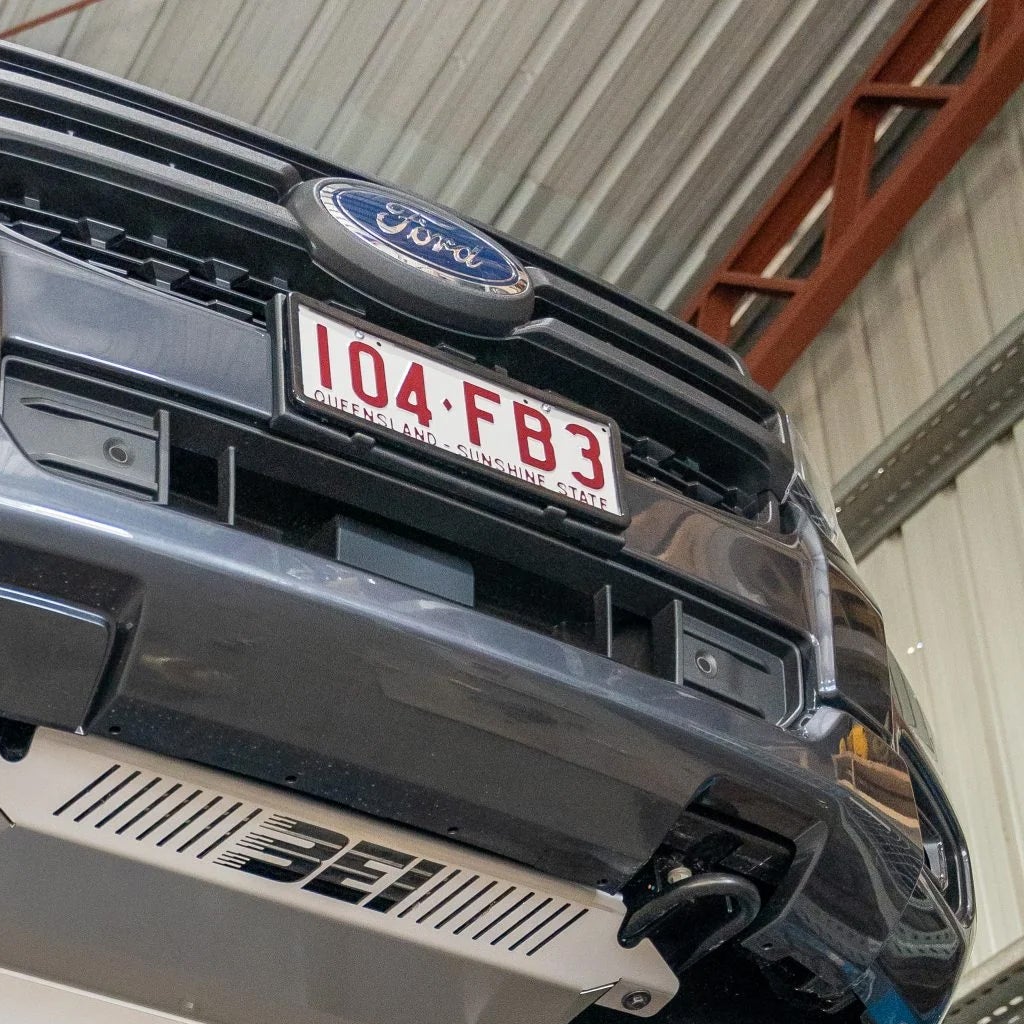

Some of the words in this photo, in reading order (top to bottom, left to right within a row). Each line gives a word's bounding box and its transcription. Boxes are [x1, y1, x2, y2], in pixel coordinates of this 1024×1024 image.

[376, 202, 484, 269] Ford
[314, 389, 436, 446] QUEENSLAND
[457, 444, 545, 486] SUNSHINE
[557, 481, 607, 511] STATE
